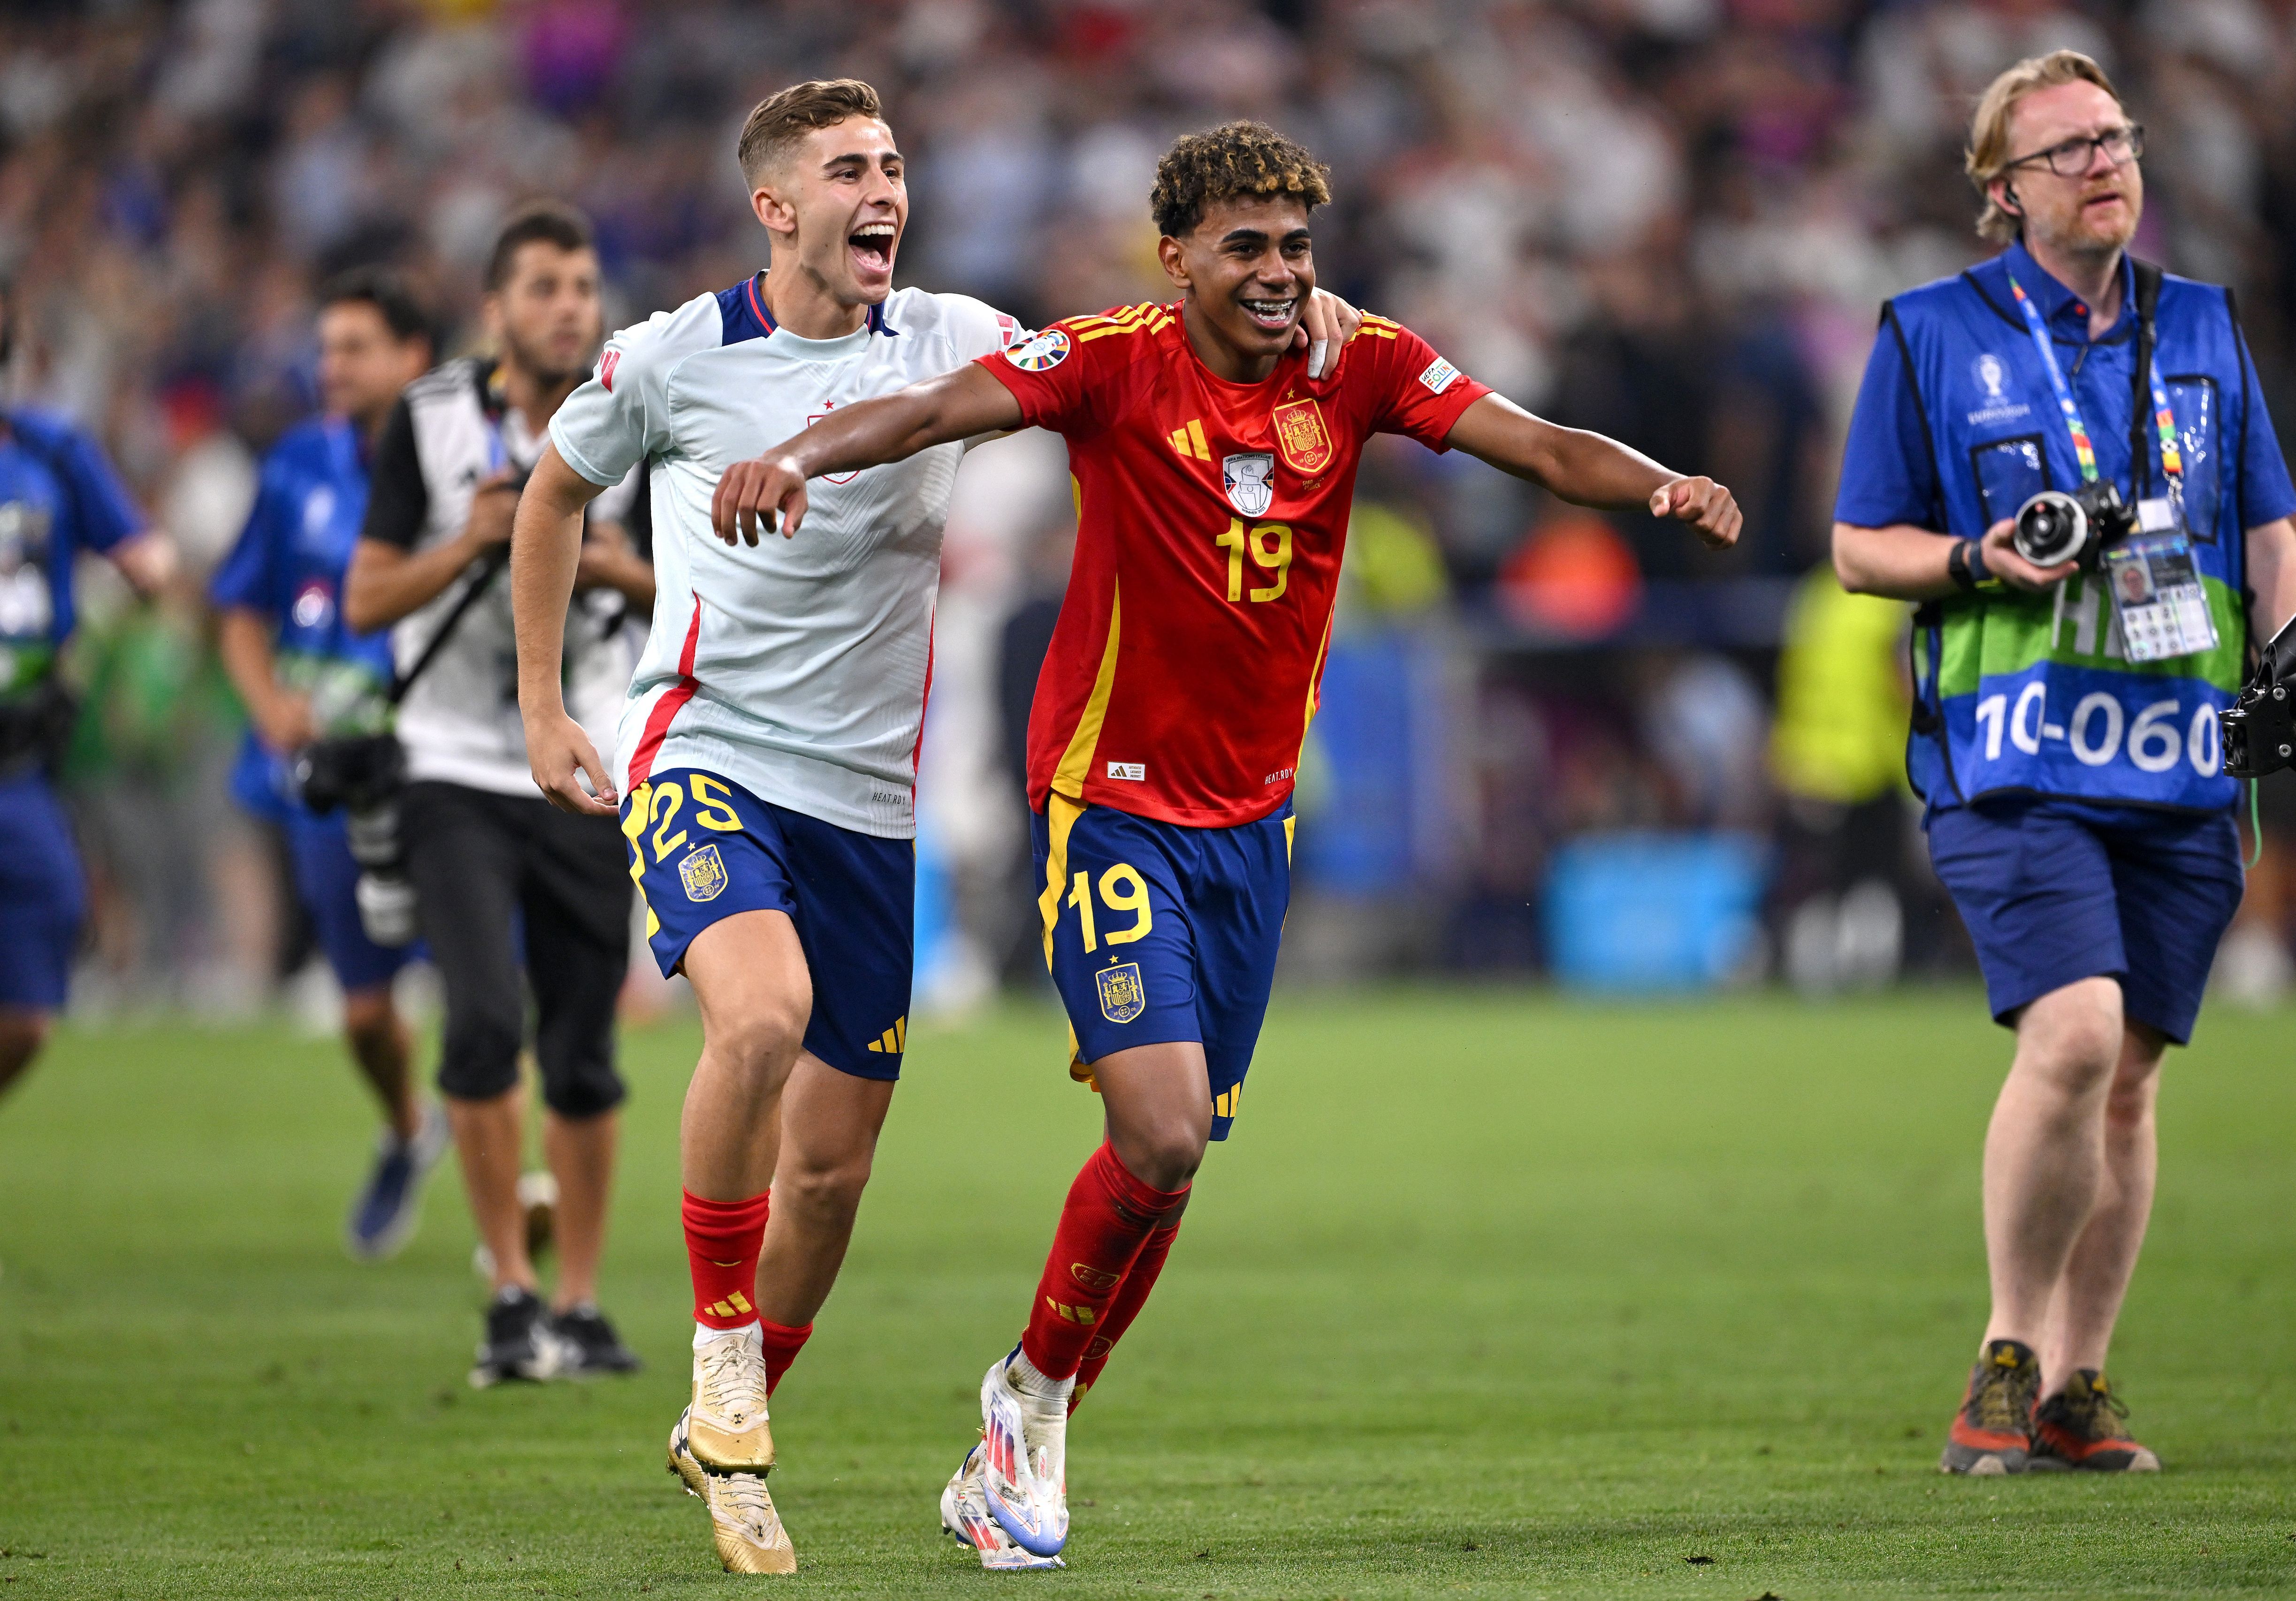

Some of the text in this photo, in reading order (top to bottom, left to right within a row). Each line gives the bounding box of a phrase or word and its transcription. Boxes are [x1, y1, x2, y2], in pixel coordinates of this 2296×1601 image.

[1421, 368, 1435, 382] UEFA
[1215, 517, 1292, 602] 19
[1976, 680, 2220, 778] 10-060
[872, 792, 906, 805] HEAT.RDY
[1265, 767, 1293, 785] HEAT.RDY
[649, 774, 744, 864] 25
[1068, 863, 1152, 954] 19
[954, 1500, 979, 1516] 50
